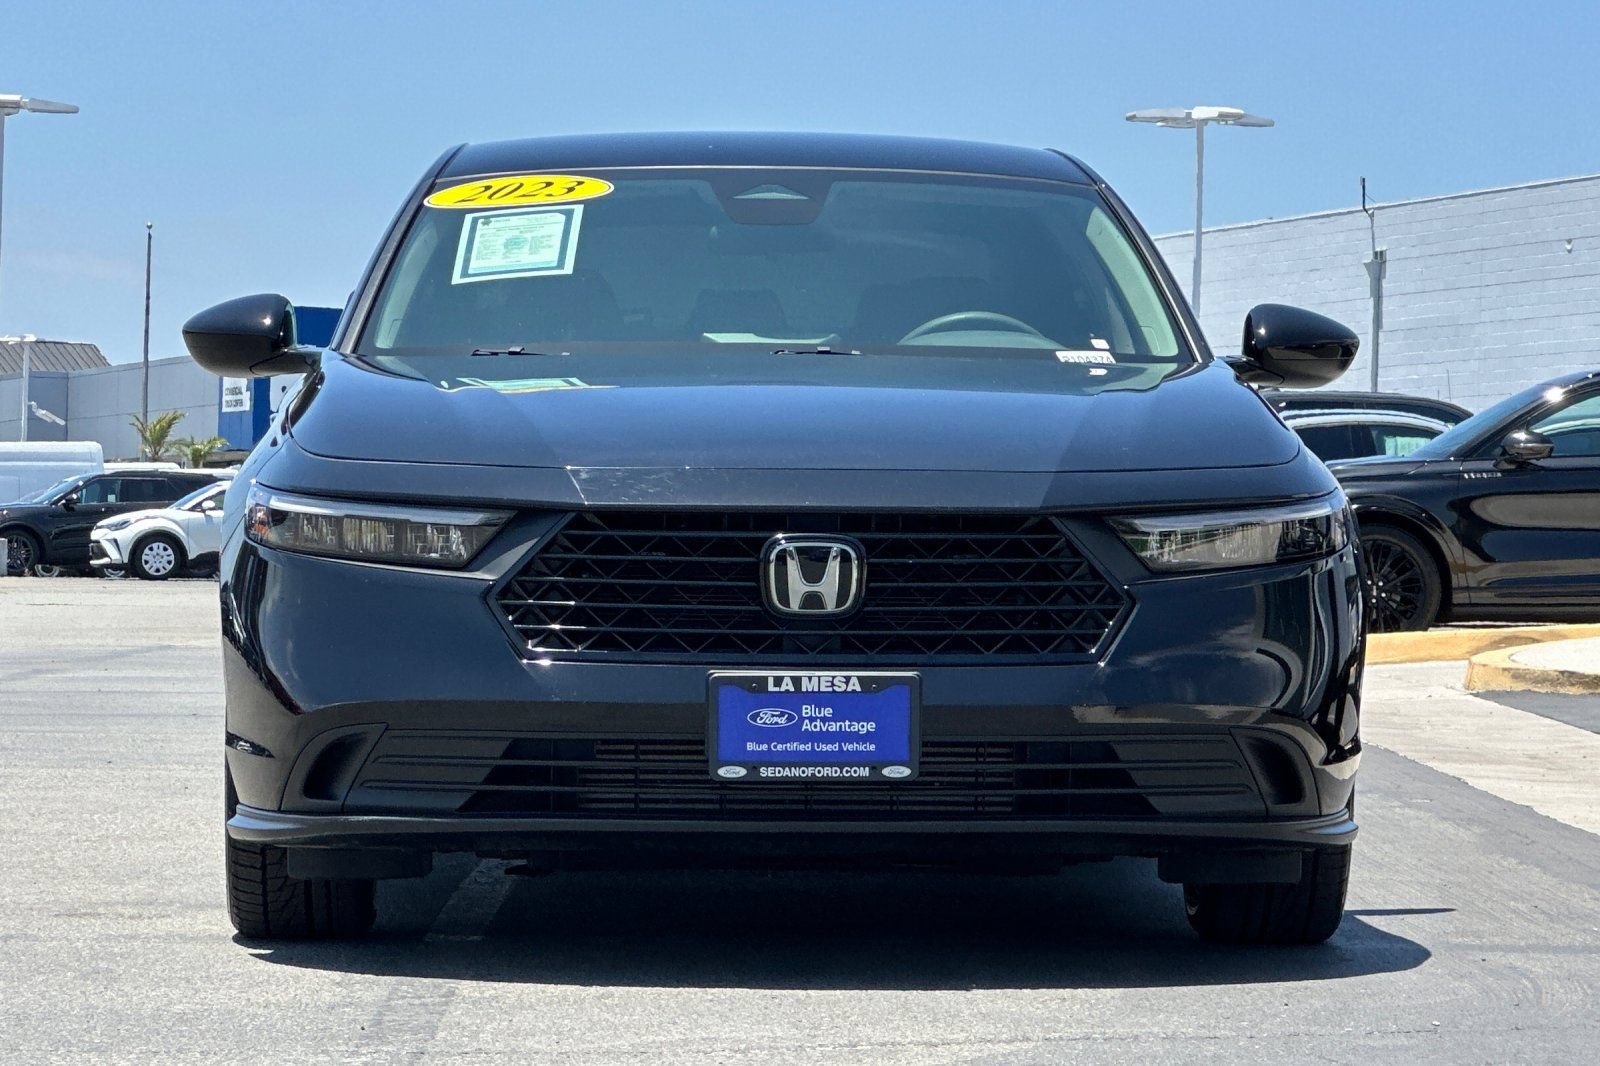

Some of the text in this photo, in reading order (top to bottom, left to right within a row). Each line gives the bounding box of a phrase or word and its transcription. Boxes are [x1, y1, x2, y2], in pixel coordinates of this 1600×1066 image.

[454, 180, 586, 204] 2023
[767, 676, 862, 692] LA MESA
[756, 709, 789, 725] Ford
[801, 704, 833, 718] Blue
[801, 719, 876, 735] Advantage
[746, 741, 876, 752] Blue Certified Used Vehicle
[759, 766, 870, 778] SEDANOFORD.COM
